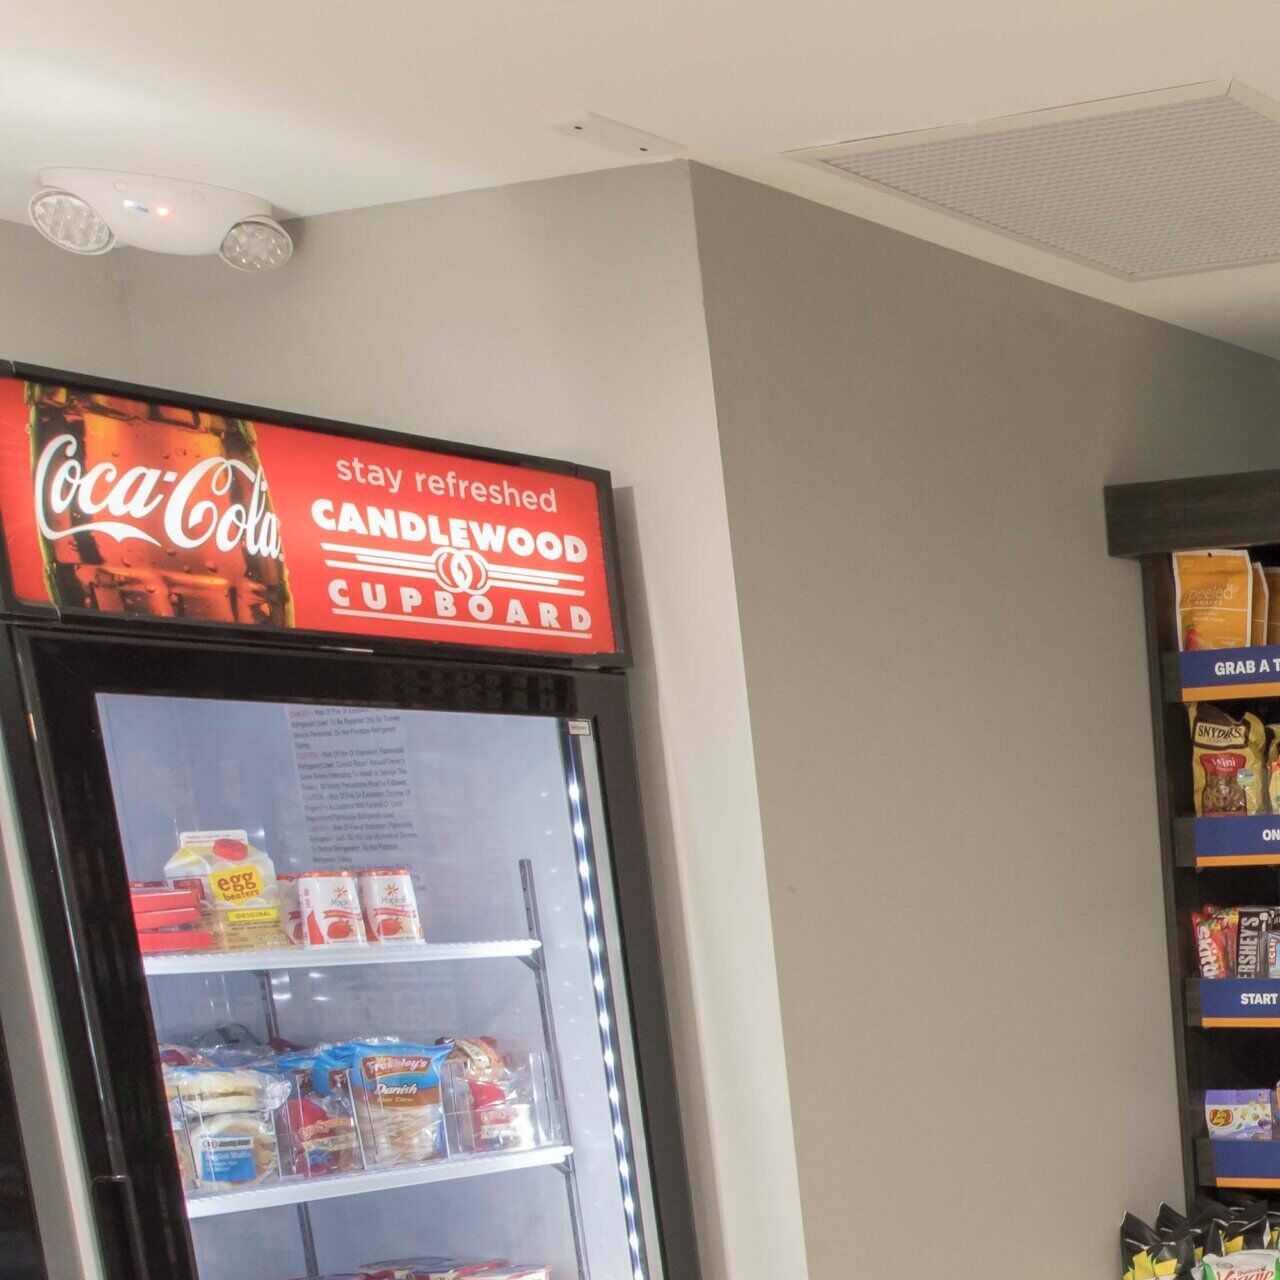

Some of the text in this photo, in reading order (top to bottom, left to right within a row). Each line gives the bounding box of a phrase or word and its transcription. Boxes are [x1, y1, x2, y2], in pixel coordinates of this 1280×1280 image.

[34, 434, 284, 562] Coca-Cola
[336, 457, 558, 514] stay refreshed
[311, 499, 588, 563] CANDLEWOOD
[328, 578, 592, 632] CUPBOARD
[1215, 660, 1256, 676] GRAB
[1260, 659, 1270, 672] A
[217, 871, 257, 892] egg
[1241, 993, 1278, 1005] START
